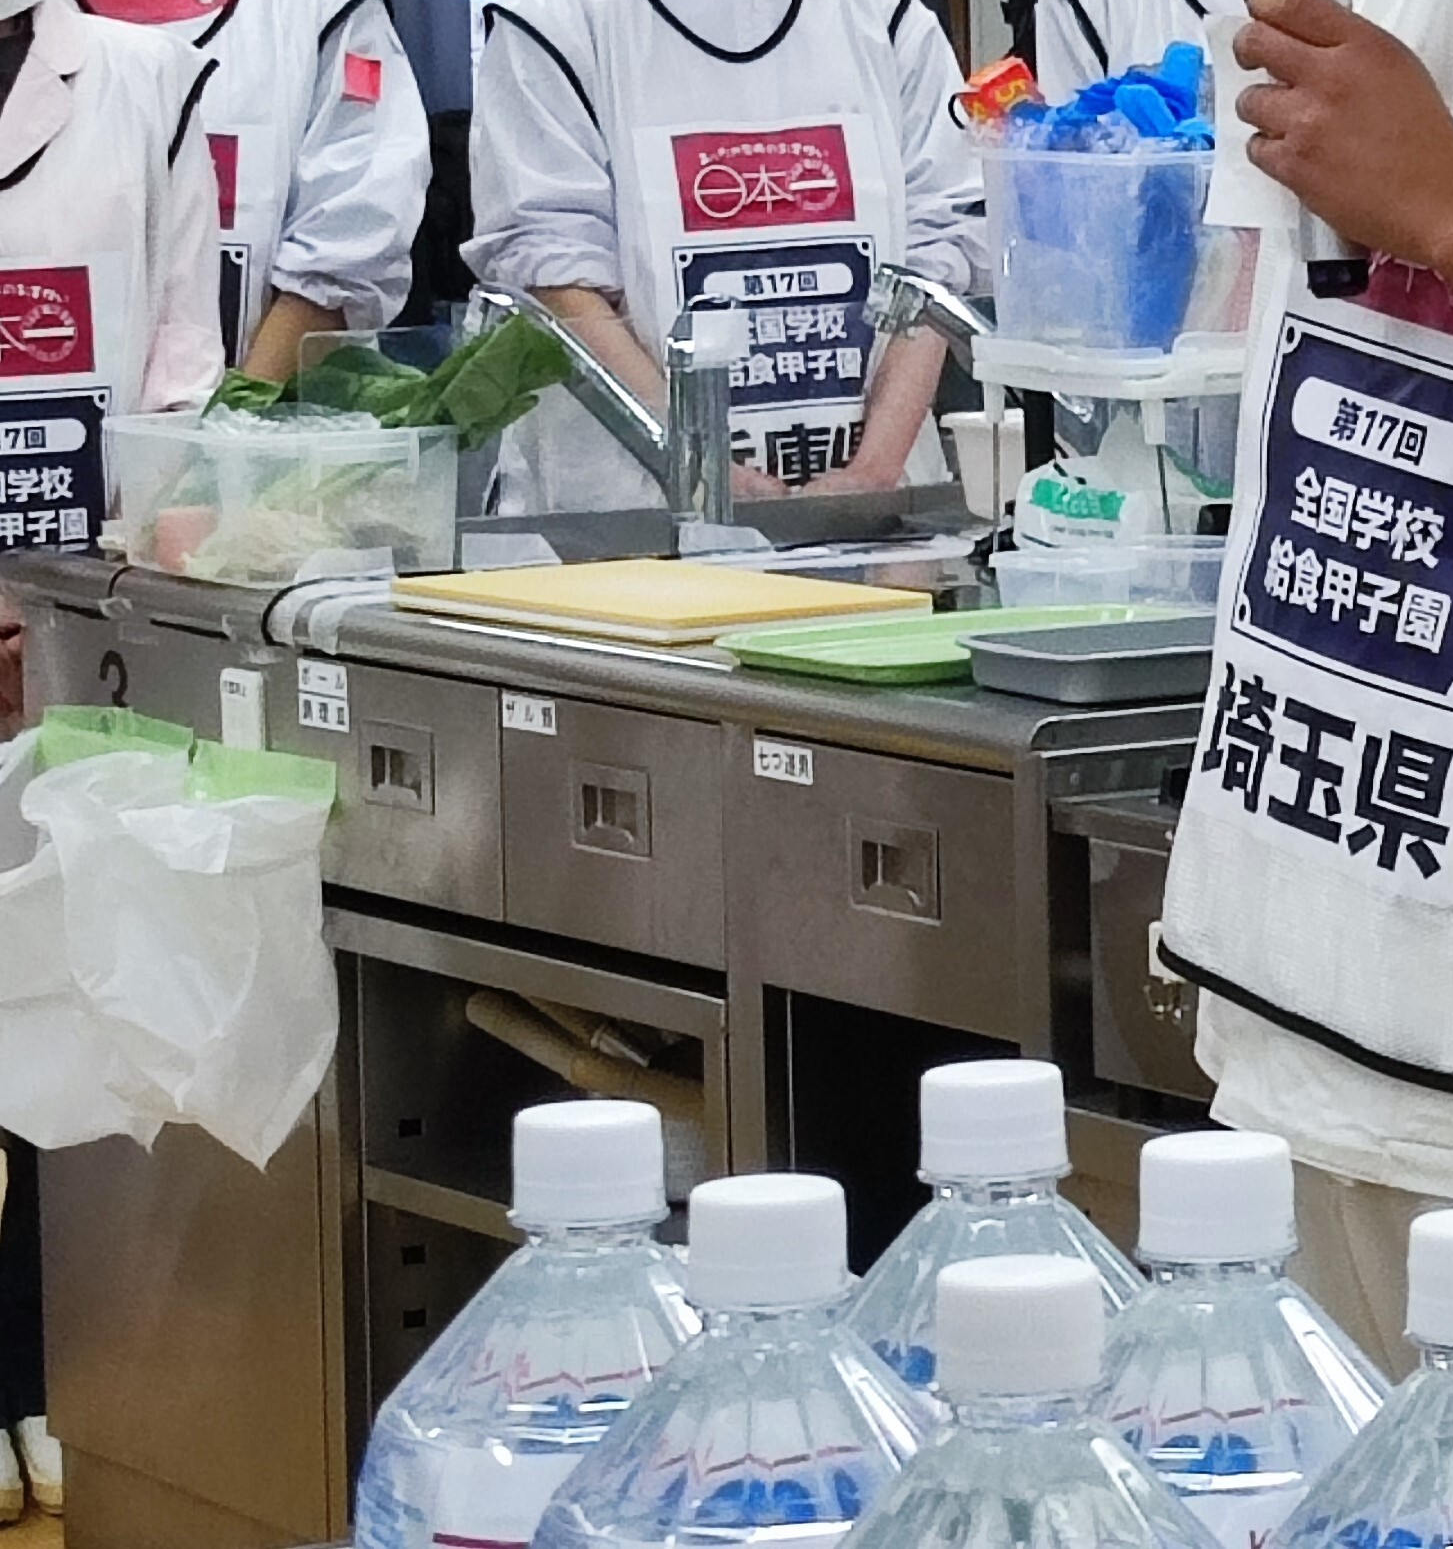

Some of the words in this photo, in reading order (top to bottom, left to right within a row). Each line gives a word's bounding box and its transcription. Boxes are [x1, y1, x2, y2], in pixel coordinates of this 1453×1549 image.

[743, 270, 819, 296] 第17回
[748, 306, 848, 344] 国学校
[1330, 399, 1428, 468] 第17回
[0, 465, 73, 502] 学校
[1290, 467, 1446, 569] 全国学校
[1264, 534, 1453, 654] 給食甲子園
